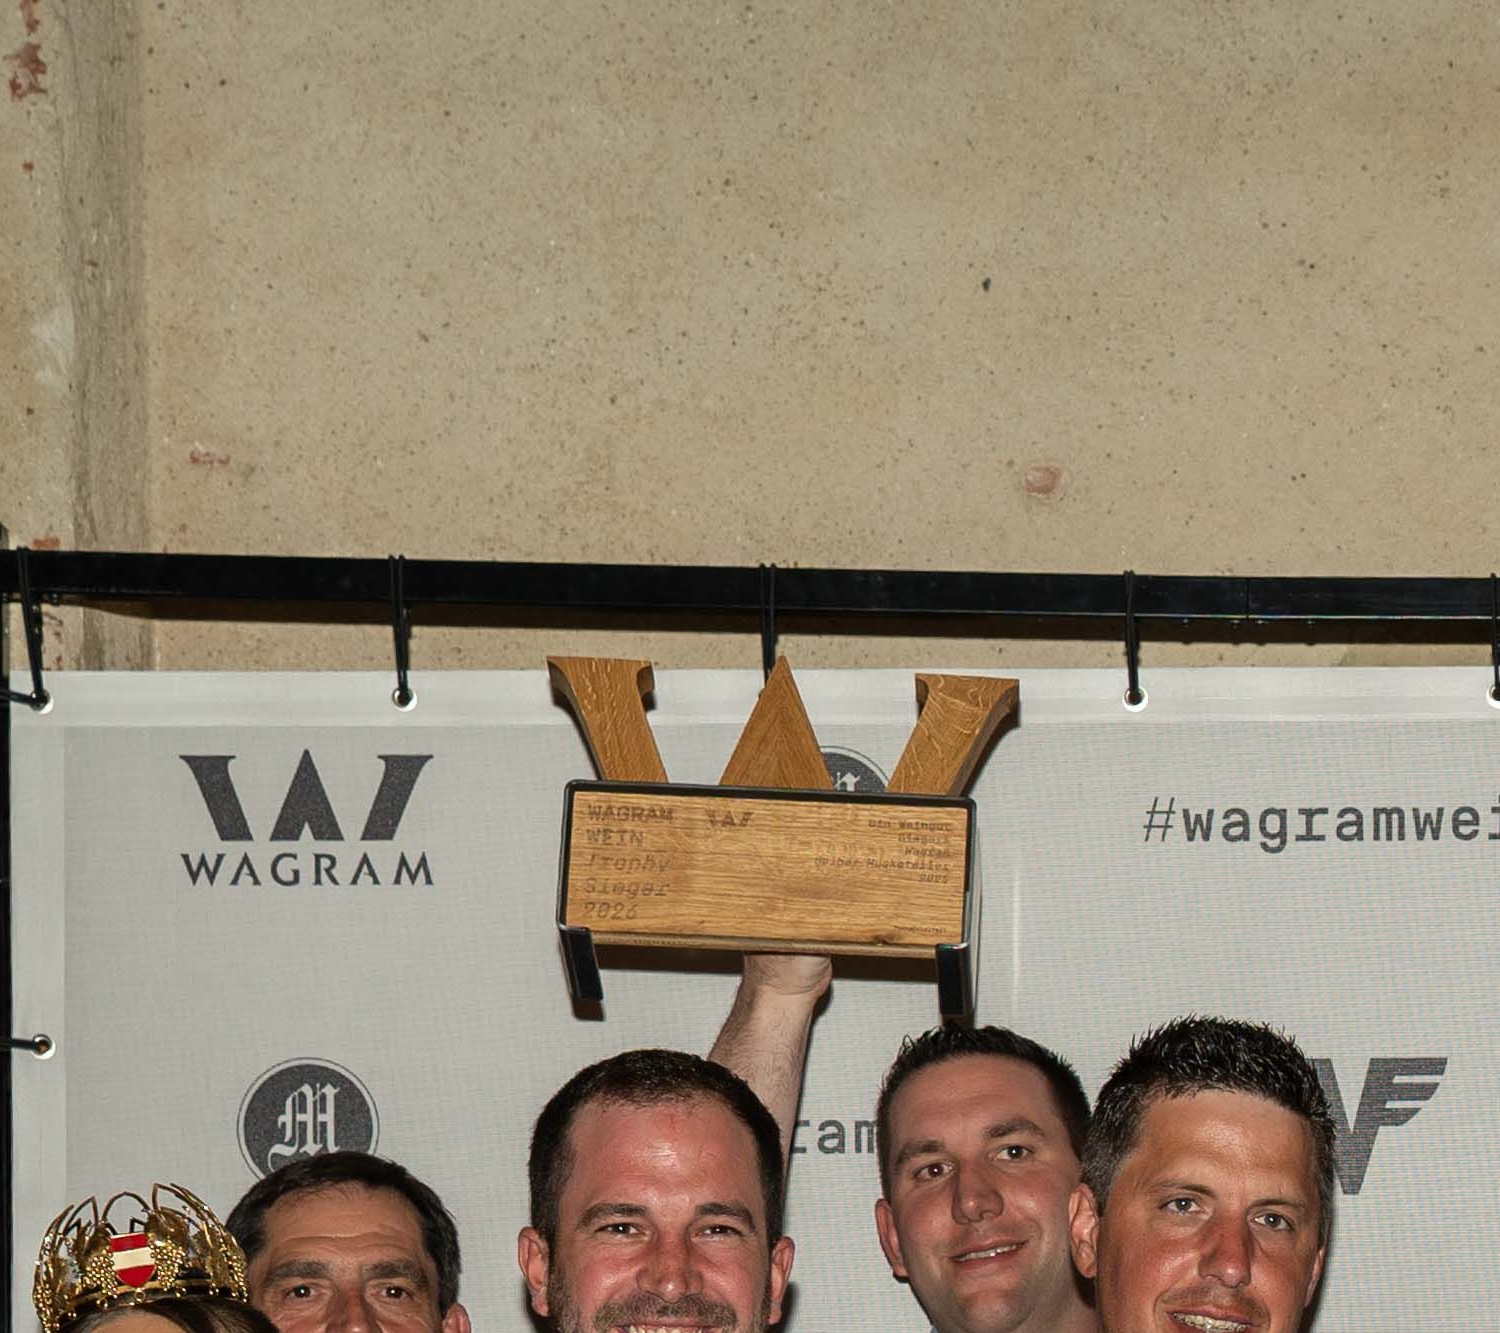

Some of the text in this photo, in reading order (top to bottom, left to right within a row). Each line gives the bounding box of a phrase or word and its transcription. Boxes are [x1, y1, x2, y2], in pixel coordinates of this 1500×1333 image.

[587, 803, 674, 824] WAGRAM
[586, 827, 645, 849] WEIN
[181, 851, 434, 887] WAGRAM
[583, 878, 671, 900] Sieger
[582, 901, 639, 921] 2026
